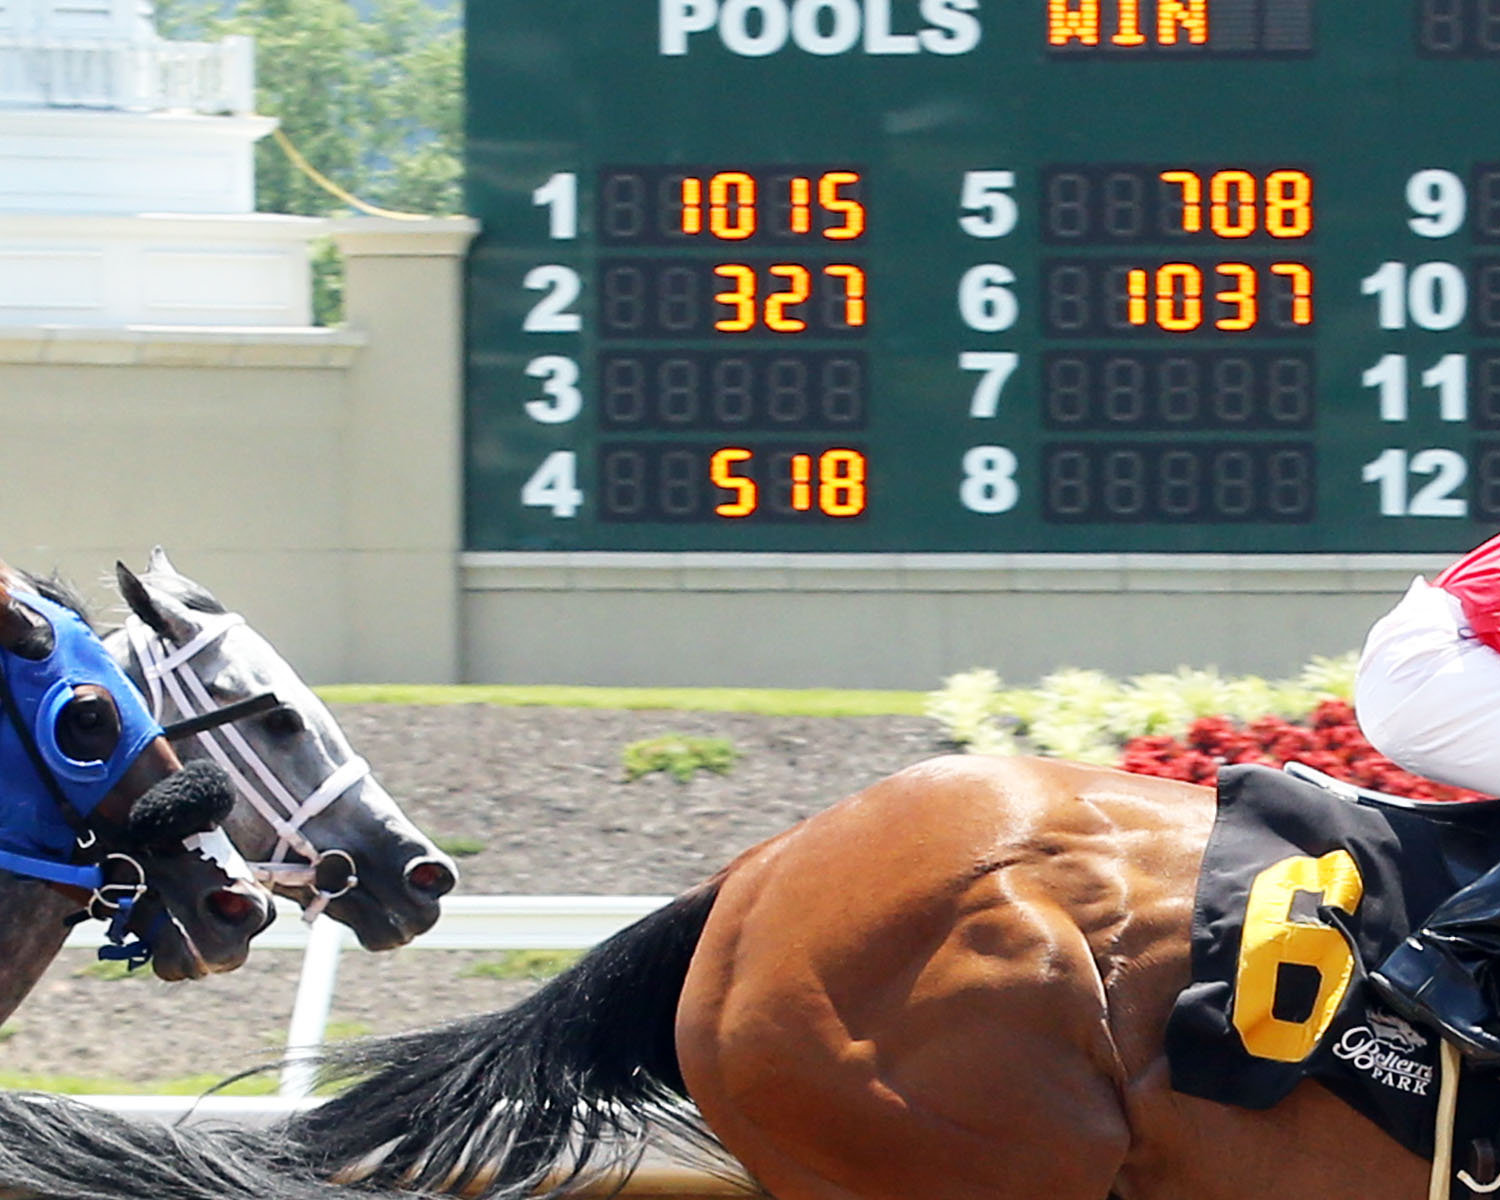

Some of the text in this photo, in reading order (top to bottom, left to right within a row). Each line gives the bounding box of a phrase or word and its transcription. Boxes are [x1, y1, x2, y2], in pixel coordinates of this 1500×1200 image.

[659, 0, 981, 56] POOLS
[1047, 0, 1209, 47] WIN
[532, 172, 866, 240] 1 1015
[959, 170, 1313, 238] 5 708
[1406, 169, 1465, 237] 9
[523, 263, 866, 332] 2 327
[959, 262, 1313, 331] 6 1037
[1361, 262, 1466, 330] 10
[524, 355, 582, 423] 3
[959, 352, 1018, 418] 7
[1362, 354, 1467, 421] 11
[521, 448, 867, 517] 4 518
[960, 446, 1018, 513] 8
[1362, 449, 1467, 516] 12
[1232, 850, 1363, 1063] 6
[1371, 1066, 1428, 1096] PARK
